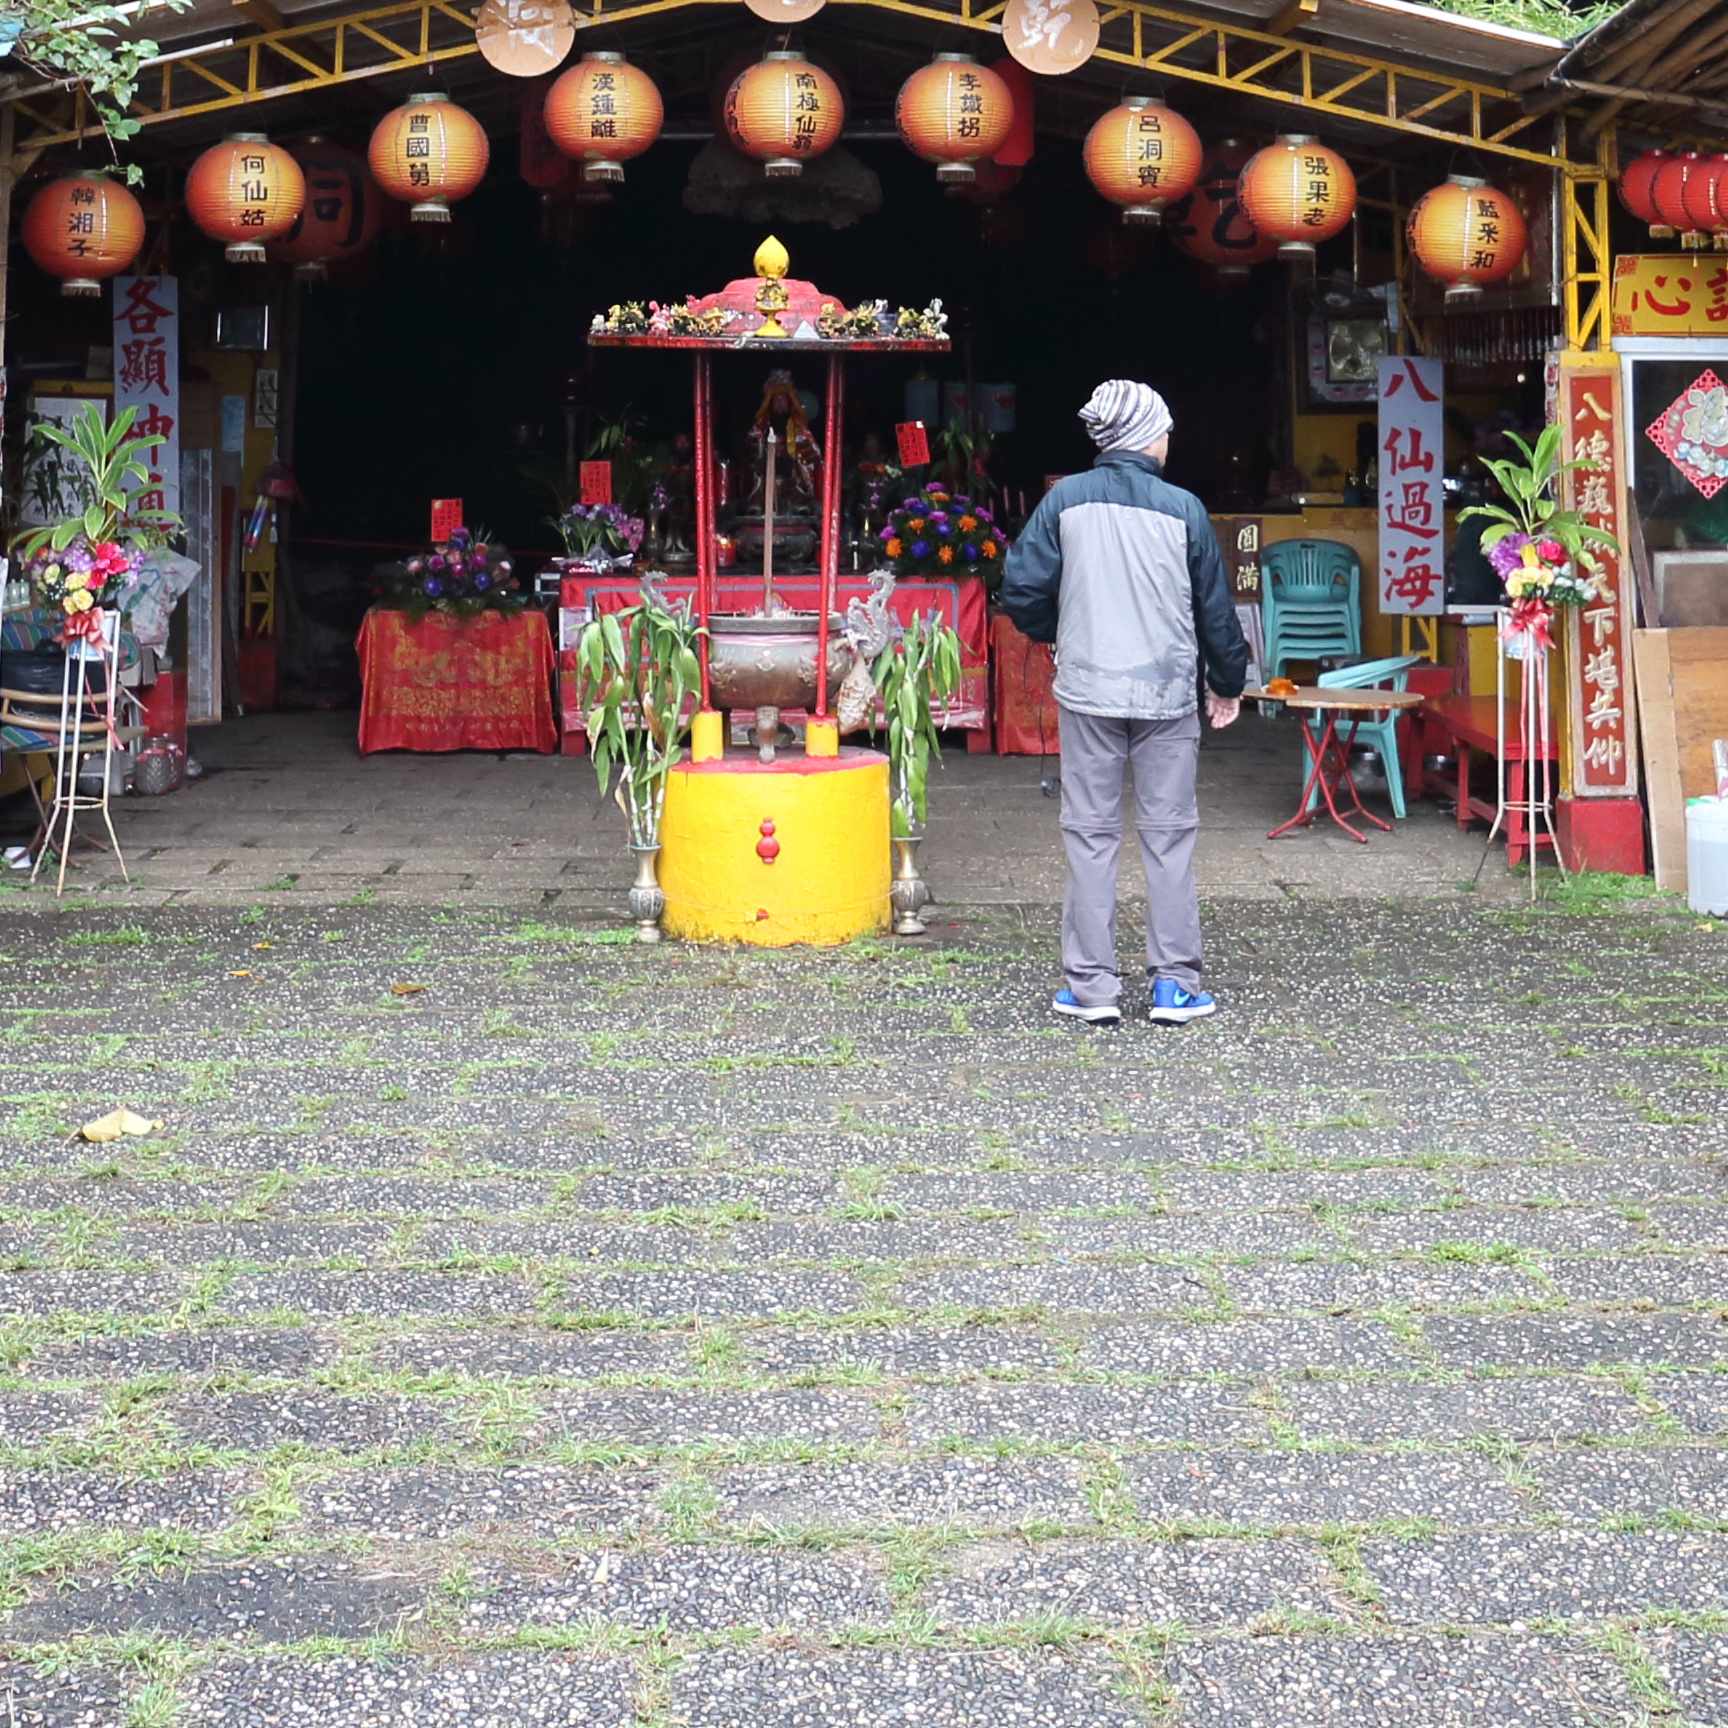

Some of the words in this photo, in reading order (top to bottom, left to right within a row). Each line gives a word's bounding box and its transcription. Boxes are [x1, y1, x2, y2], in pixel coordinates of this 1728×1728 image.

[791, 72, 820, 151] 南極仙翁
[405, 113, 432, 188] 曹國舅
[1137, 115, 1163, 190] 呂洞賓
[66, 185, 96, 258] 韓湘子
[239, 154, 268, 228] 何仙姑
[1301, 155, 1331, 227] 張果老
[1470, 198, 1501, 269] 藍采和
[1382, 358, 1443, 610] 八仙過海
[1237, 524, 1260, 591] 圓滿
